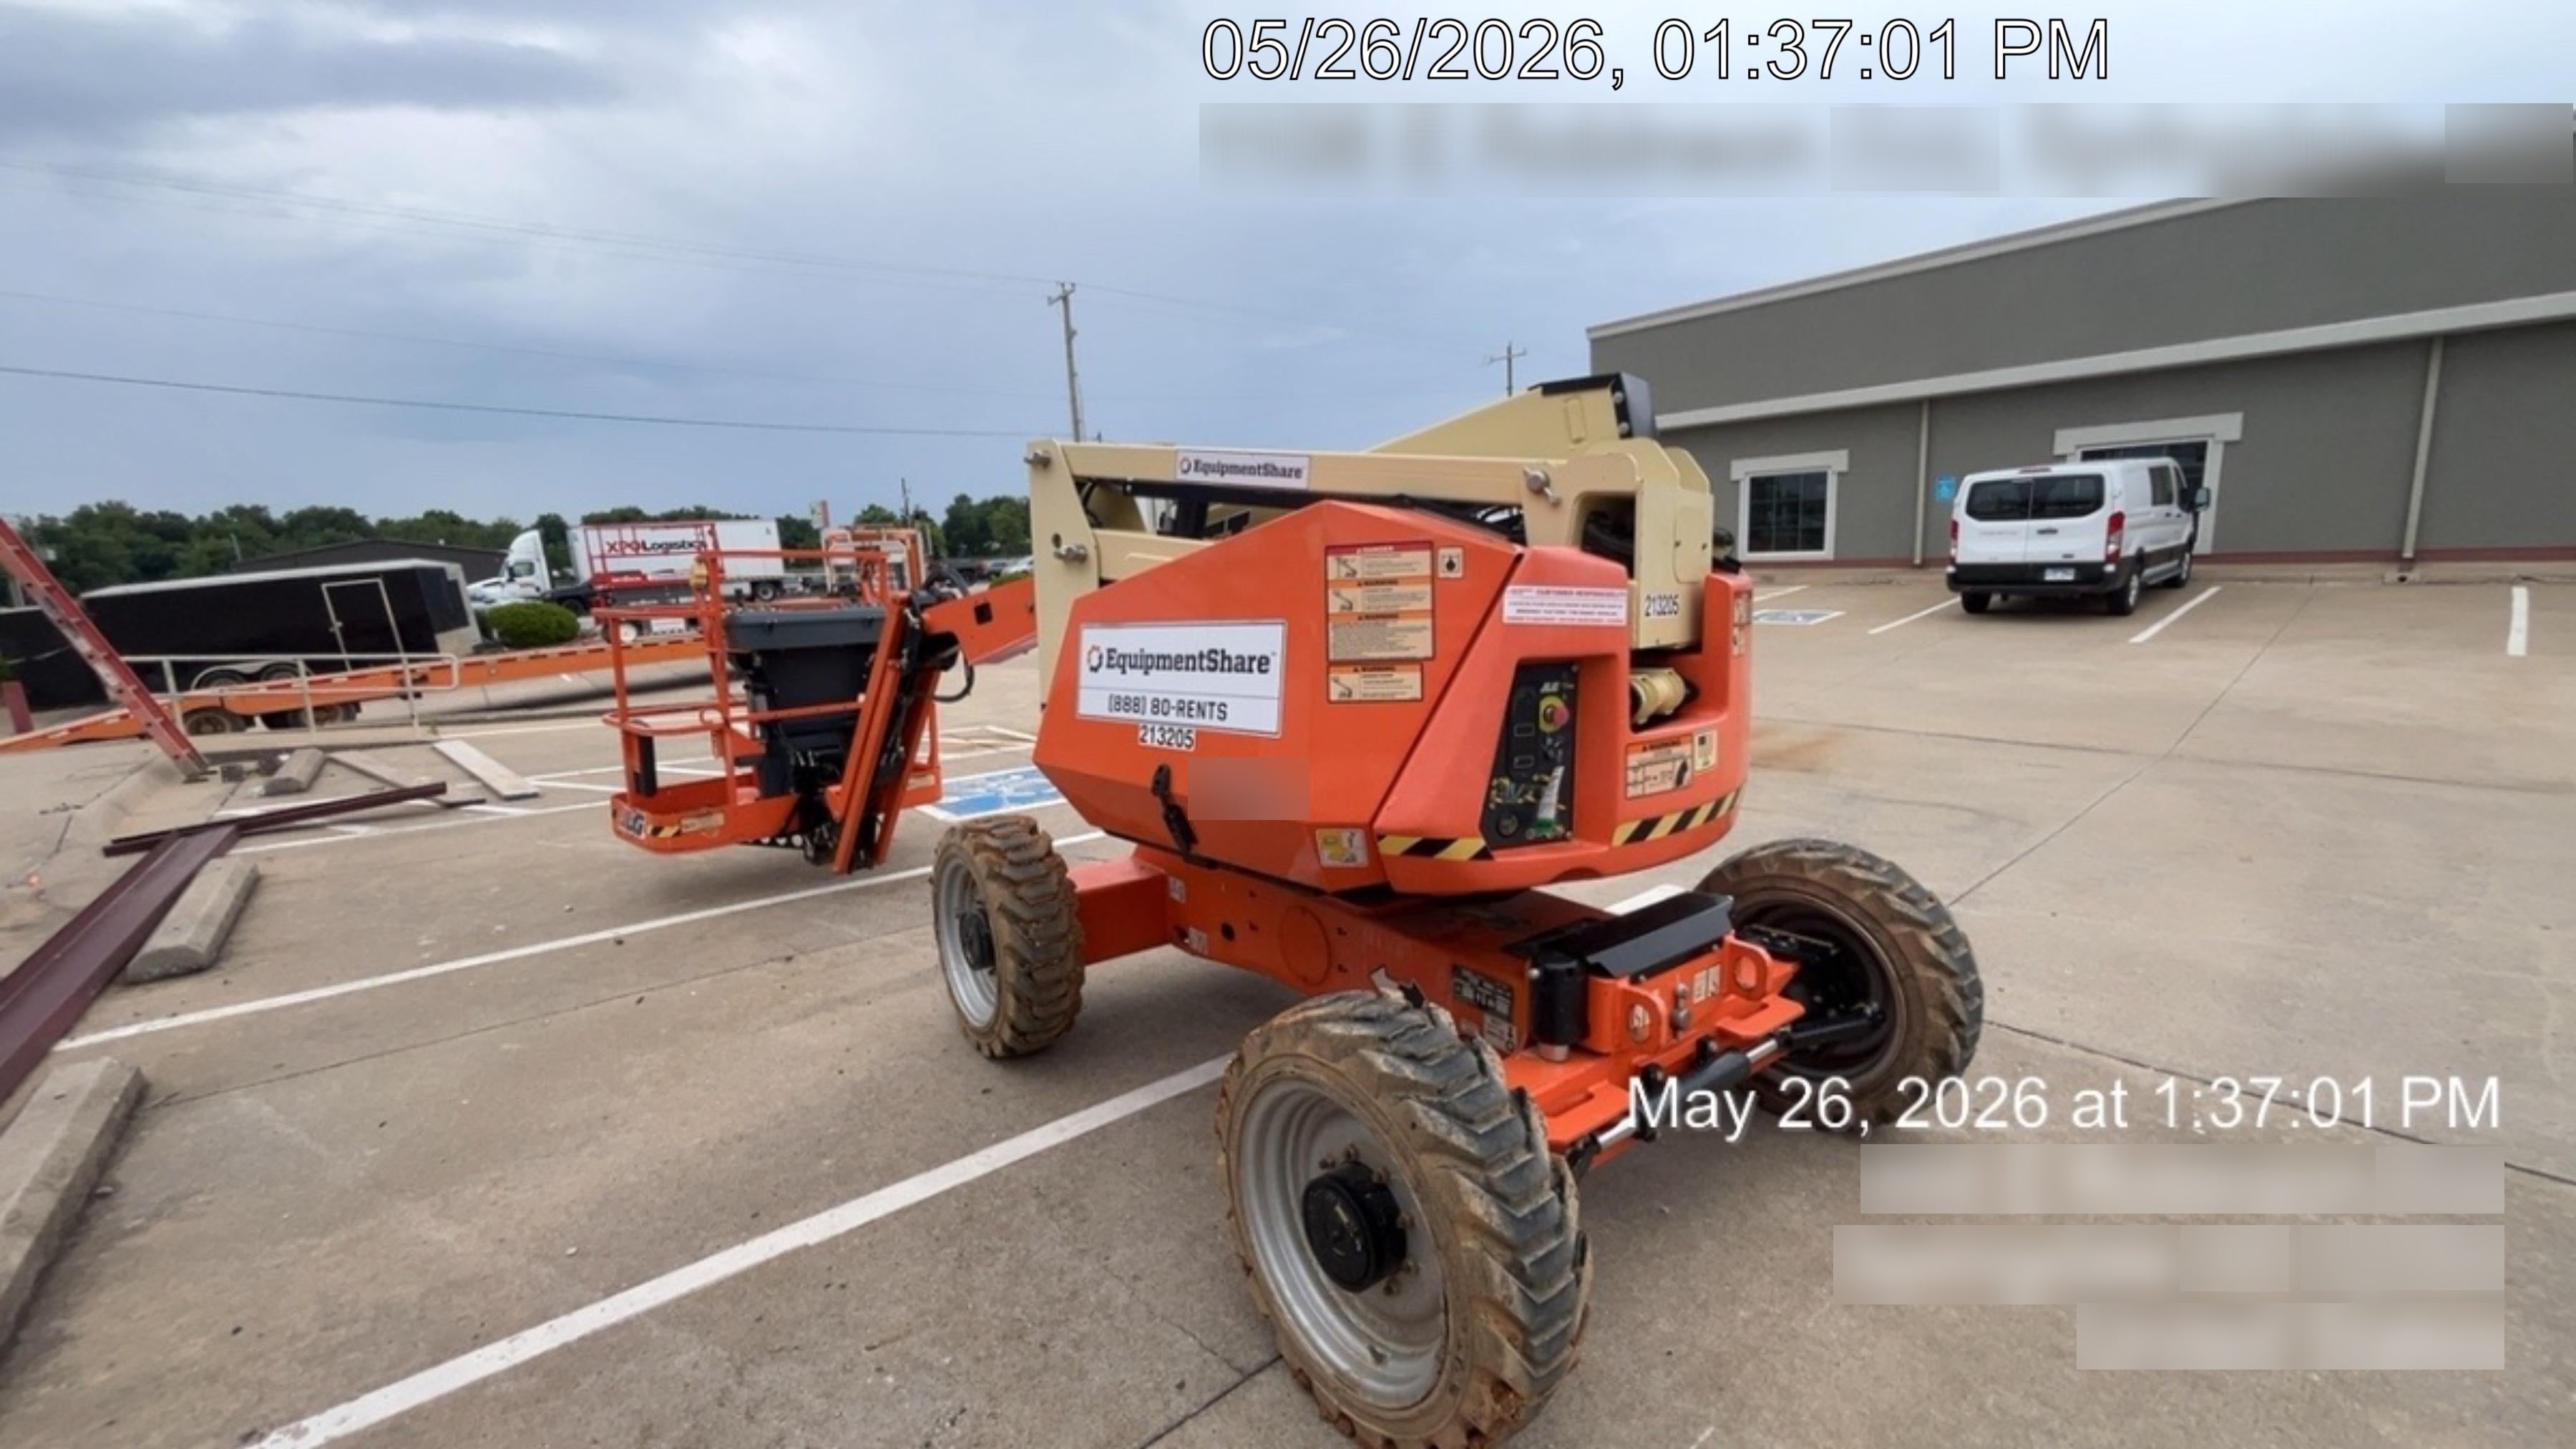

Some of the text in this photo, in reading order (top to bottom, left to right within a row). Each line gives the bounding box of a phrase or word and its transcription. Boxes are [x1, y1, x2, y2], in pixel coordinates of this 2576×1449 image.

[1193, 459, 1303, 479] EquipmentShare
[1644, 594, 1679, 617] 213205
[1105, 647, 1271, 675] EquipmentShare
[1151, 697, 1229, 722] 80-RENTS
[1140, 724, 1194, 749] 213205
